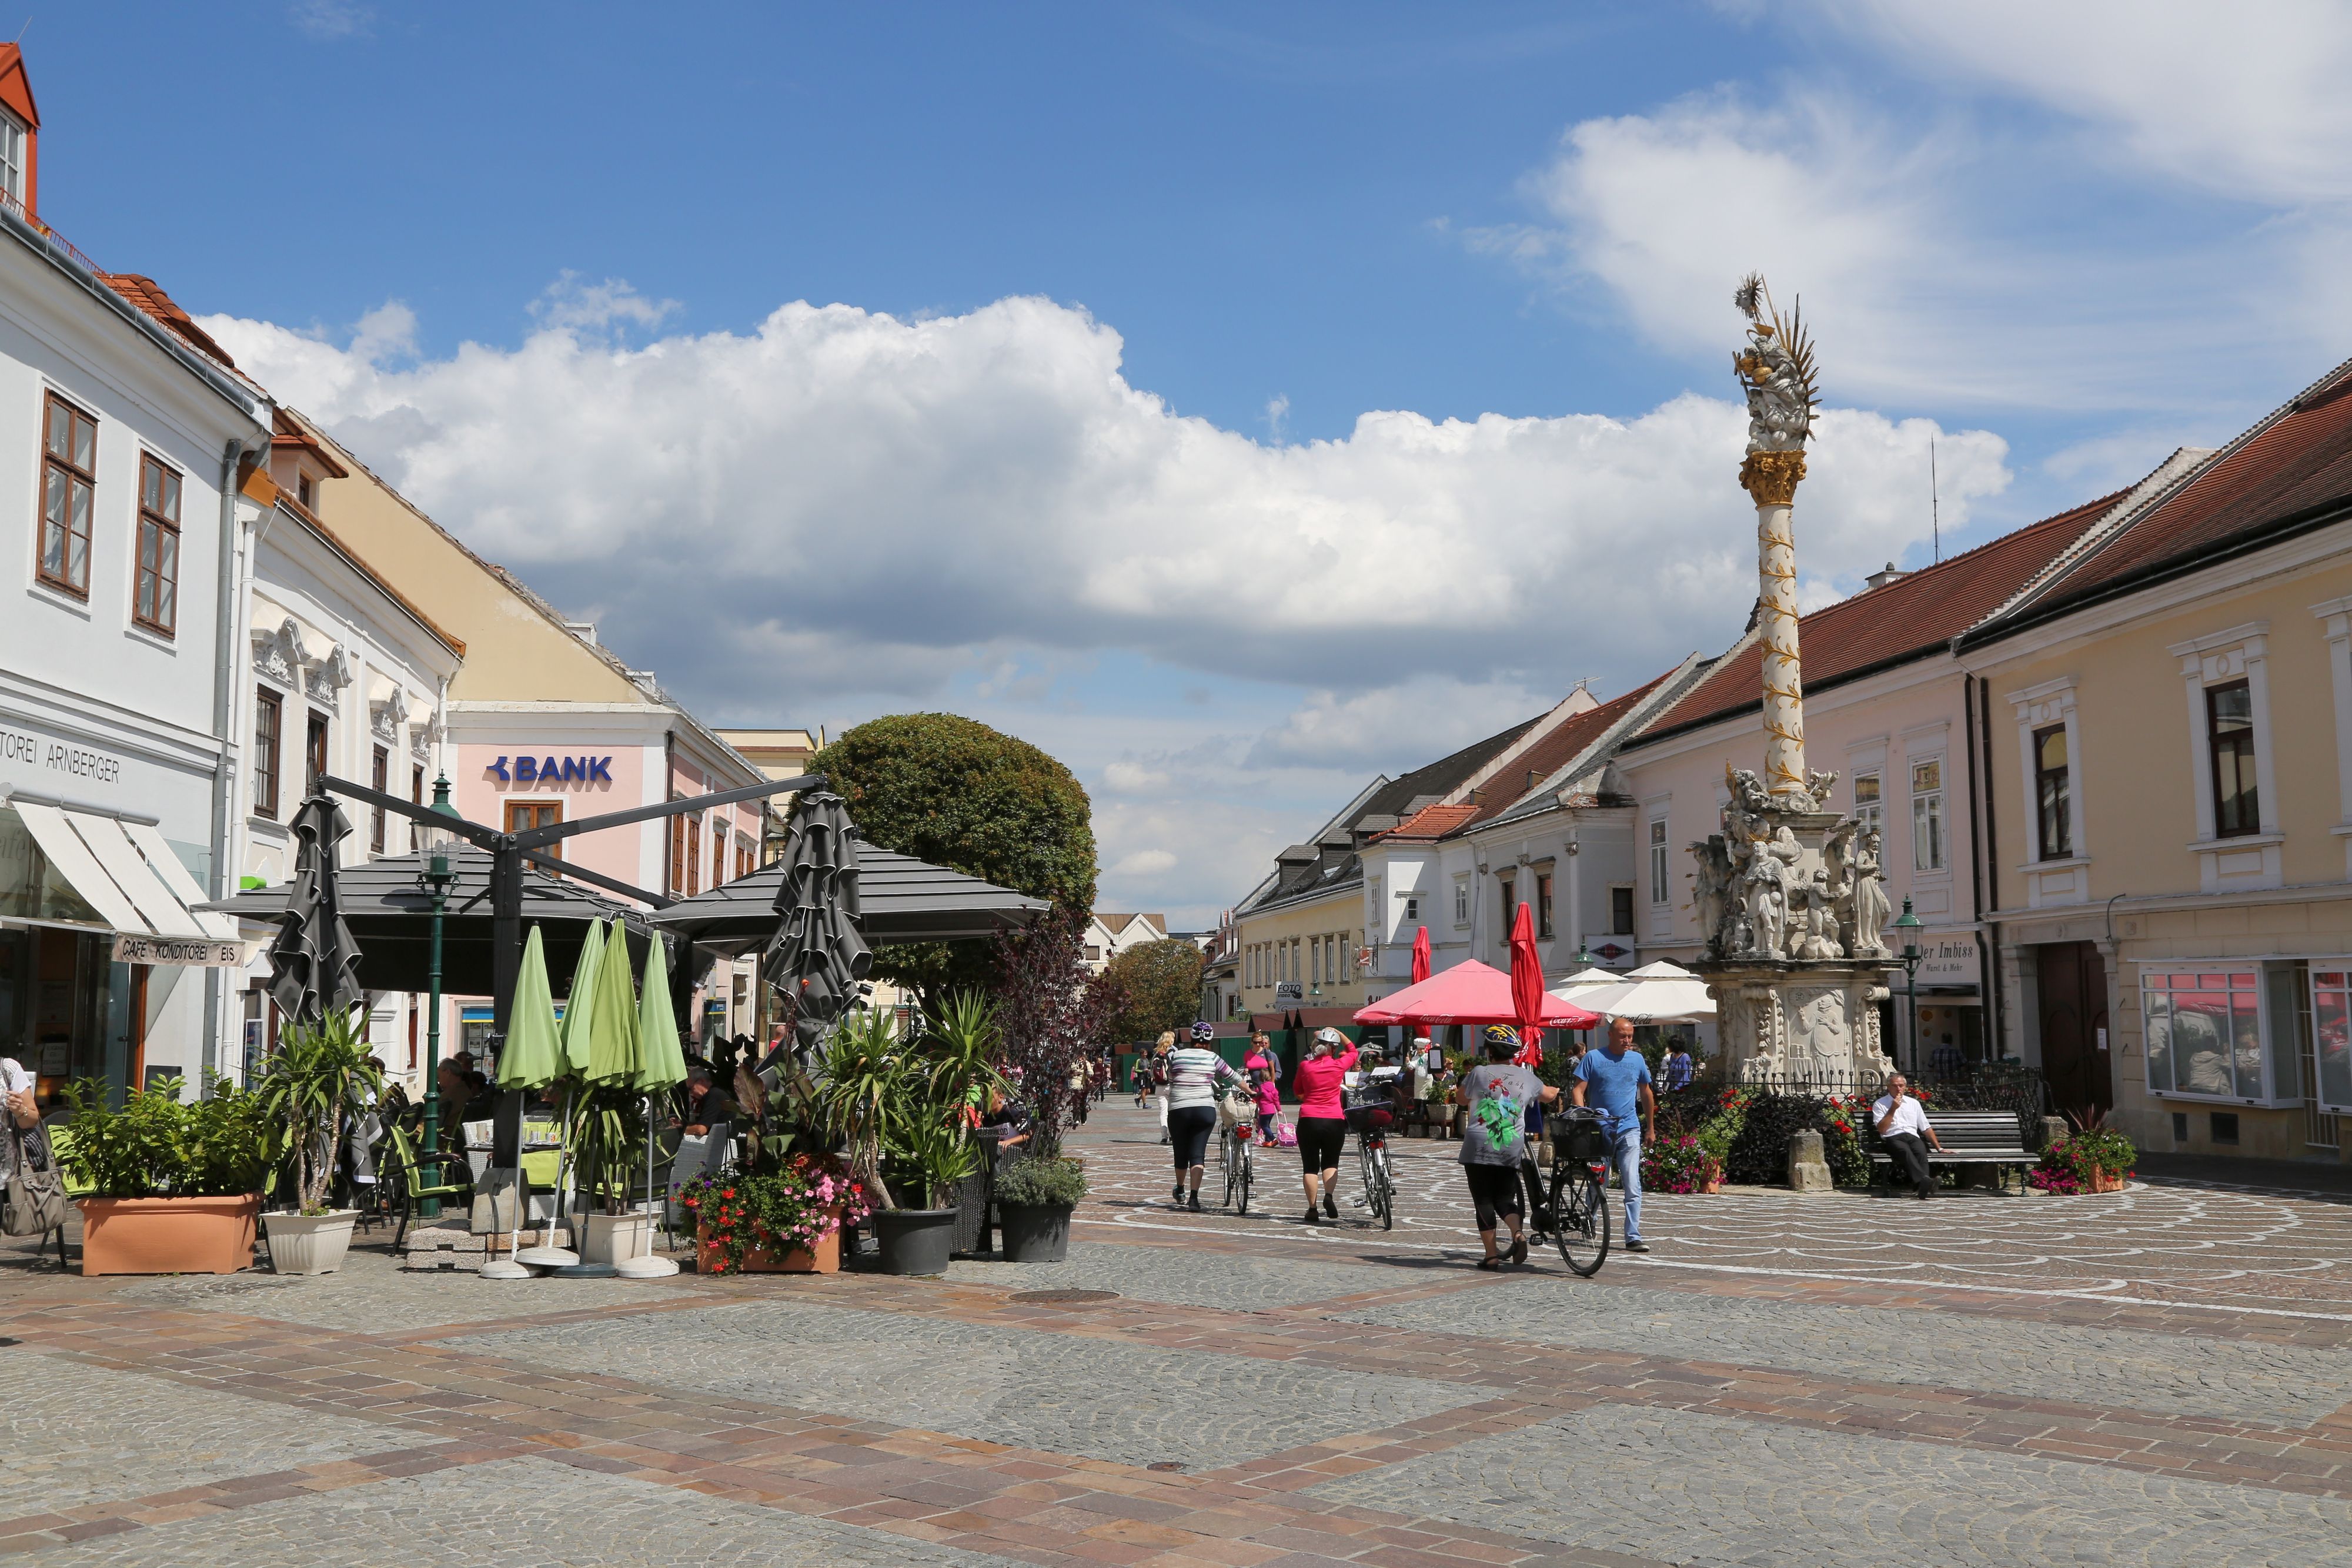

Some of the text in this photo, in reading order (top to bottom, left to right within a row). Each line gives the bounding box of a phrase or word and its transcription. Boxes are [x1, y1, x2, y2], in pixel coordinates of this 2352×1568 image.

[0, 731, 119, 784] TOREI ARNBERGER
[516, 756, 613, 781] BANK
[122, 940, 235, 961] CAFE KONDITOREI EIS
[1939, 941, 1973, 958] Imbiss
[1943, 963, 1947, 972] &
[1949, 964, 1963, 972] Mehr
[1278, 984, 1301, 992] FOTO
[1619, 1013, 1654, 1025] ca-Cola
